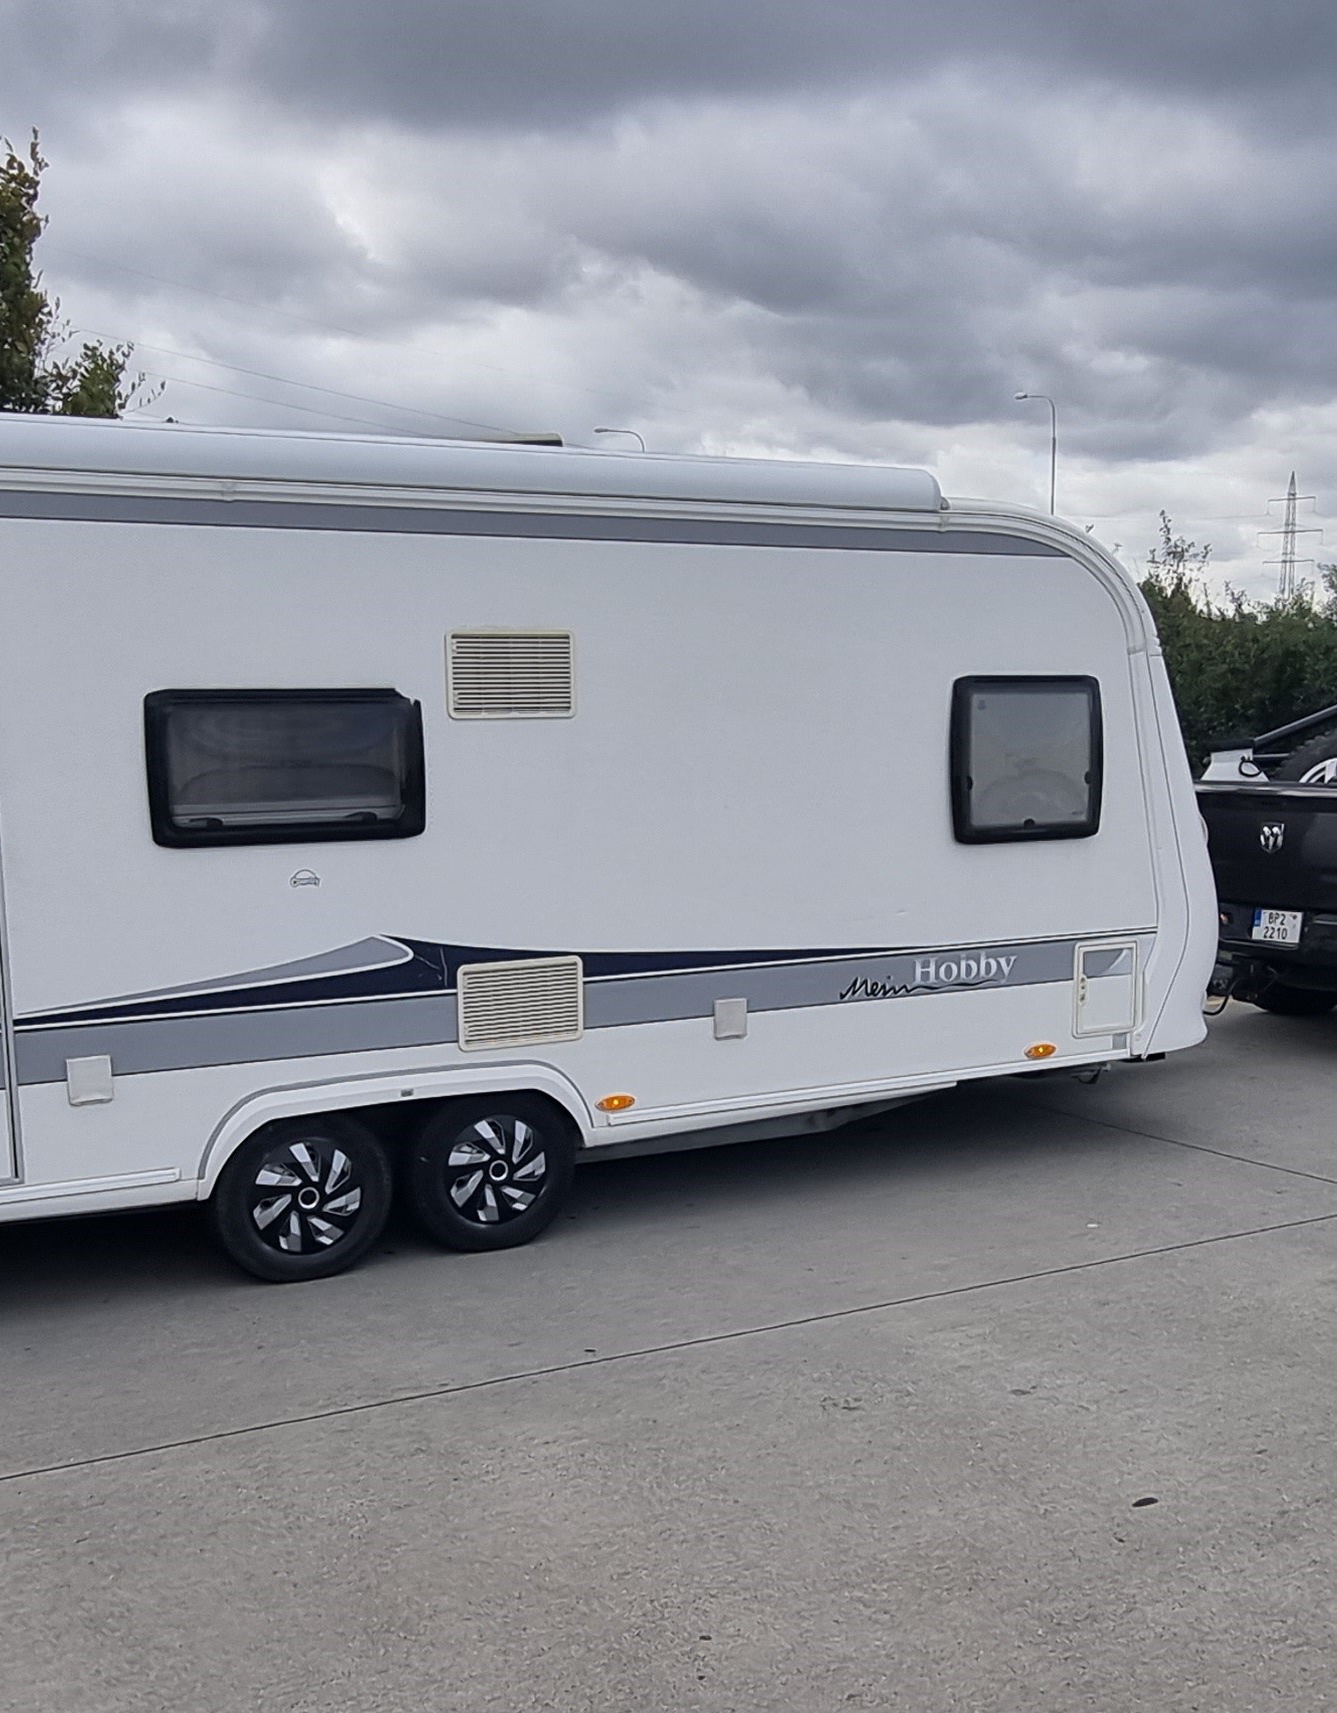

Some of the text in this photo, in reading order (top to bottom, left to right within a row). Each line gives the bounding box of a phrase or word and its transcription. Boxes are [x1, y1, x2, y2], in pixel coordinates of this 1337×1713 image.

[1263, 926, 1288, 940] 2210
[839, 951, 1018, 1000] Mein Hobby
